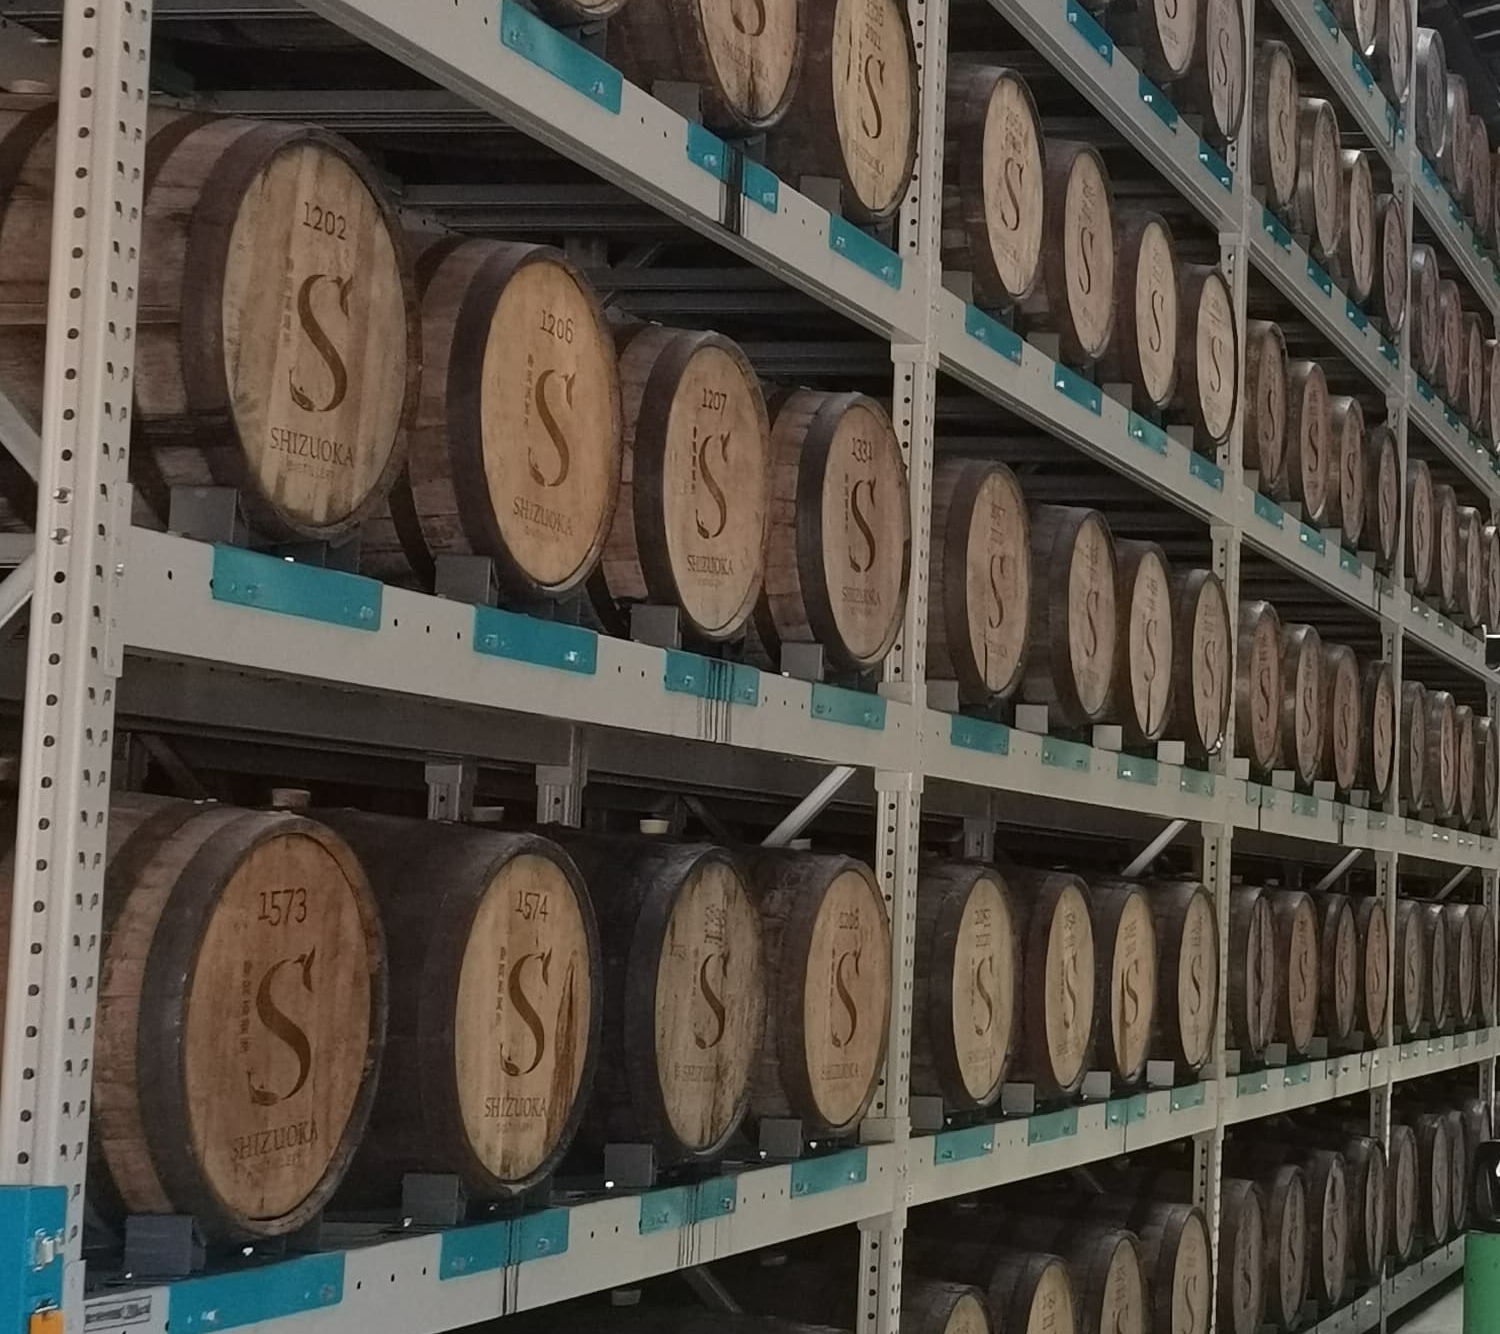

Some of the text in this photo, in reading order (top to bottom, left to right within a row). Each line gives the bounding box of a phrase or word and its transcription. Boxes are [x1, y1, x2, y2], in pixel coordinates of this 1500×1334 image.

[860, 52, 886, 140] S
[303, 202, 348, 241] 1202
[1001, 157, 1024, 231] S
[288, 271, 354, 414] S
[539, 308, 575, 345] 1206
[527, 367, 577, 489] S
[701, 387, 728, 420] 1207
[270, 425, 356, 469] SHIZUOKA
[513, 495, 576, 542] SHIZUOKA
[695, 429, 732, 541] S
[849, 473, 877, 574] S
[686, 553, 735, 576] SHIZUOKA
[257, 887, 308, 927] 1573
[514, 889, 549, 924] 1574
[246, 943, 316, 1109] S
[499, 945, 553, 1078] S
[695, 949, 728, 1051] S
[831, 942, 862, 1049] S
[973, 952, 993, 1037] S
[232, 1121, 319, 1163] SHIZUOKA
[484, 1096, 547, 1119] SHIZUOKA
